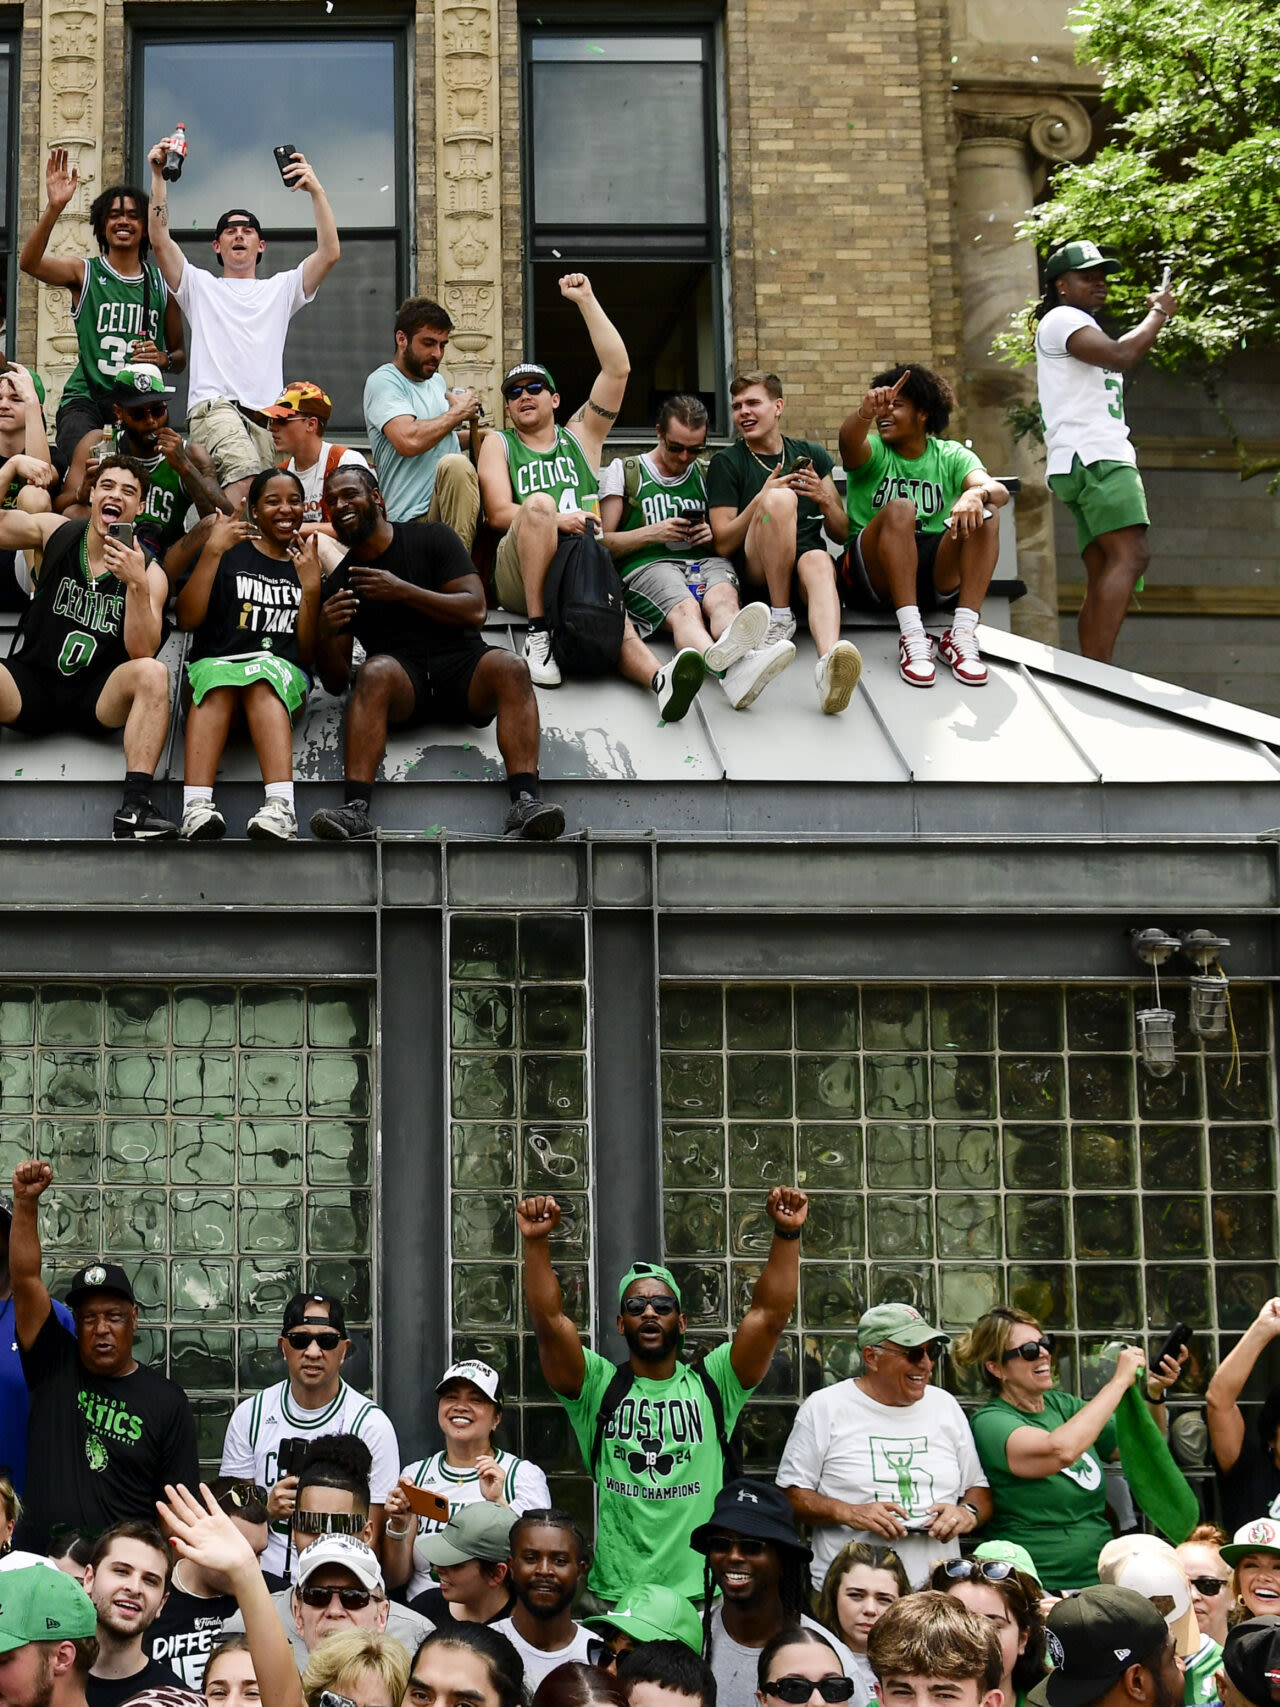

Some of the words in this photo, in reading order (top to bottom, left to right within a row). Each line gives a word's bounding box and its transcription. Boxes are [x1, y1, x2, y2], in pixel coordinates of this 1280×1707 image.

[96, 302, 159, 341] CELTIS
[97, 335, 142, 377] 3
[517, 457, 580, 495] CELTICS
[235, 575, 303, 607] WHATEV
[57, 629, 98, 677] 0
[89, 1392, 126, 1410] OSTON
[604, 1397, 704, 1445] BOSTON
[613, 1444, 628, 1460] 20
[645, 1450, 657, 1466] 18
[675, 1450, 692, 1465] 24
[605, 1476, 640, 1499] WORLD
[640, 1480, 701, 1501] CHAMPIONS
